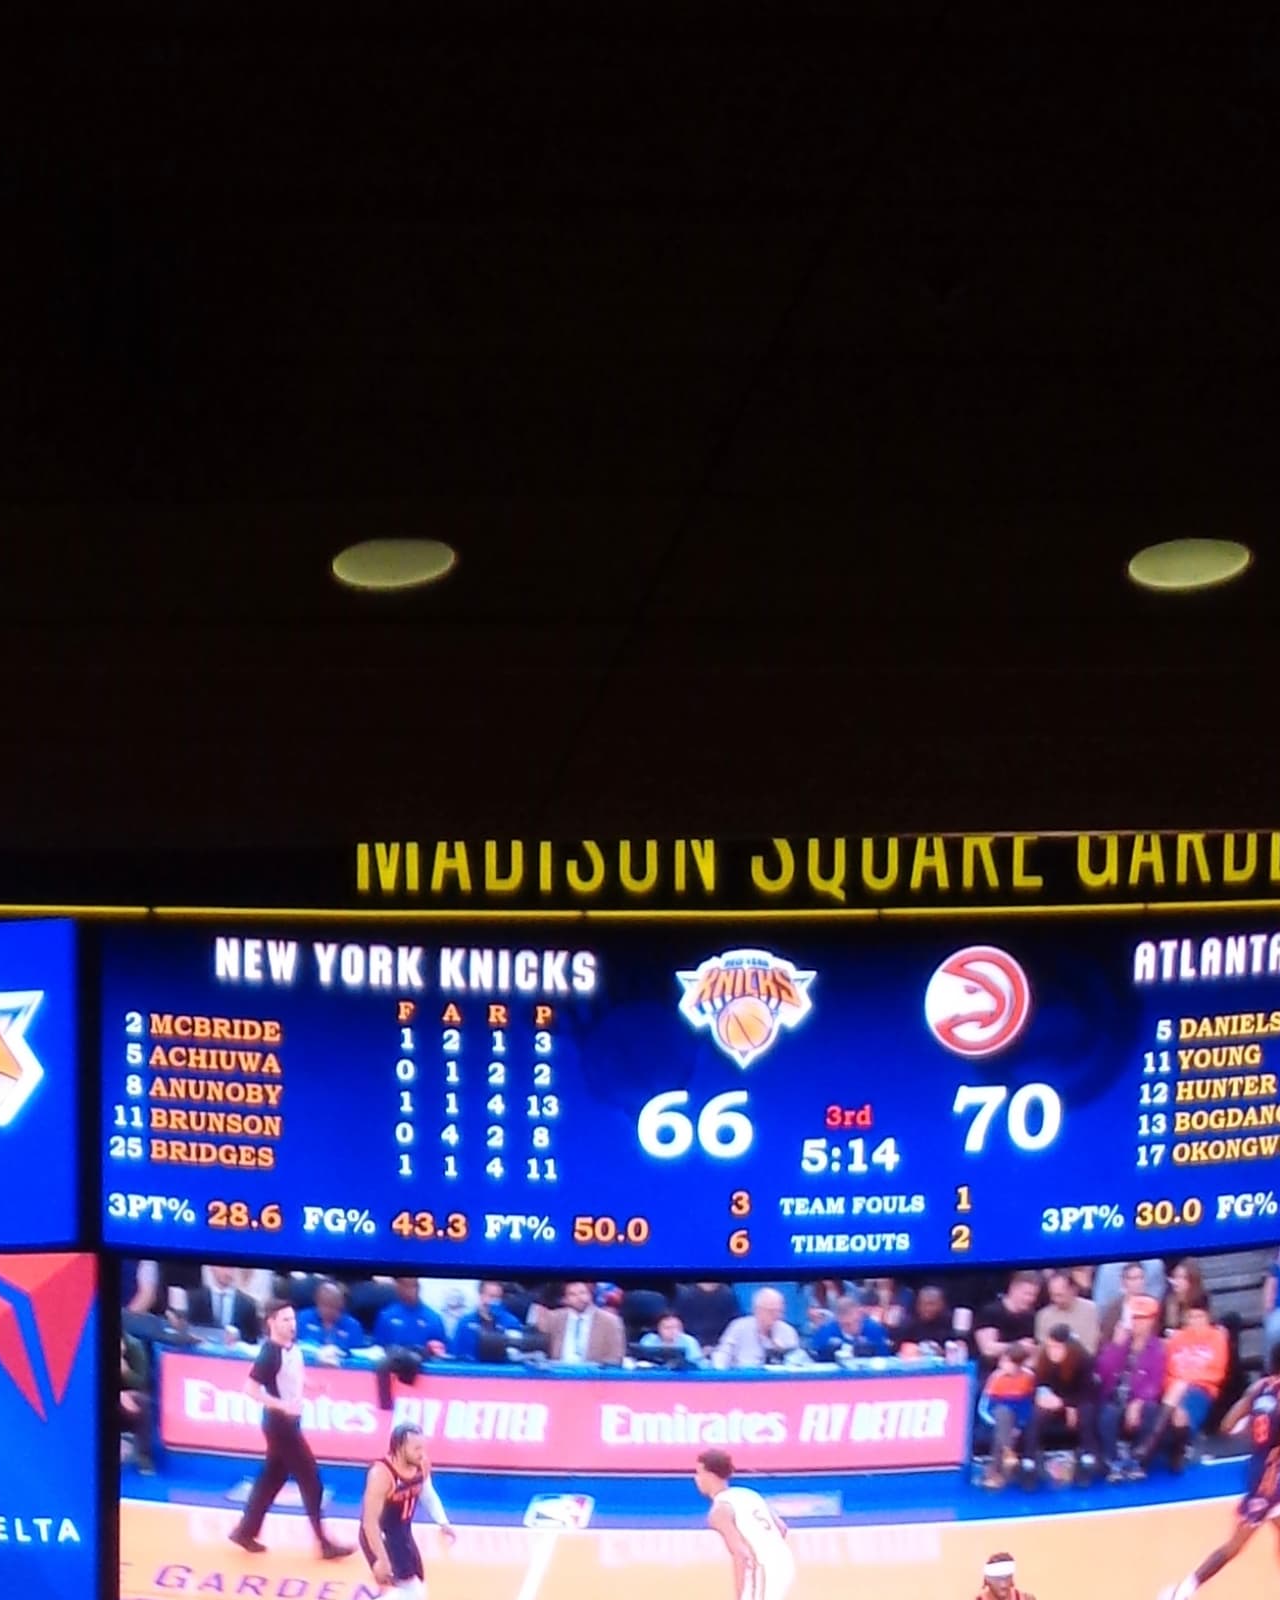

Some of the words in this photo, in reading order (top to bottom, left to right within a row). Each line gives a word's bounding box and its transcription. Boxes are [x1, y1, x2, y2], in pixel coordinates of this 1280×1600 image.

[357, 839, 714, 890] MADISON
[751, 836, 1043, 900] SQUARE
[215, 937, 297, 982] NEW
[313, 942, 424, 989] YORK
[440, 947, 596, 993] KNICKS
[693, 967, 802, 1008] KNICKS
[125, 1011, 143, 1035] 2
[150, 1013, 282, 1045] MCBRIDE
[401, 1027, 414, 1050] 1
[443, 1028, 460, 1052] 2
[492, 1030, 506, 1053] 1
[534, 1031, 552, 1053] 3
[398, 1001, 415, 1021] F
[442, 1003, 462, 1023] A
[488, 1004, 508, 1024] R
[535, 1005, 552, 1026] P
[1156, 1019, 1173, 1041] 5
[126, 1043, 143, 1065] 5
[149, 1045, 282, 1075] ACHIUWA
[396, 1059, 415, 1081] 0
[446, 1061, 459, 1083] 1
[488, 1062, 505, 1085] 2
[534, 1063, 551, 1086] 2
[1143, 1050, 1171, 1074] 11
[1177, 1044, 1262, 1071] YOUNG
[126, 1074, 143, 1096] 8
[149, 1076, 283, 1106] ANUNOBY
[400, 1091, 413, 1113] 1
[446, 1092, 459, 1115] 1
[487, 1094, 505, 1115] 4
[527, 1095, 559, 1117] 13
[1139, 1082, 1169, 1105] 12
[1175, 1073, 1278, 1102] HUNTER
[114, 1104, 144, 1128] 11
[150, 1107, 282, 1137] BRUNSON
[395, 1122, 414, 1144] 0
[441, 1124, 459, 1146] 4
[486, 1125, 504, 1148] 2
[533, 1126, 550, 1148] 8
[637, 1090, 754, 1159] 66
[826, 1104, 872, 1129] 3rd
[953, 1083, 1062, 1152] 70
[1138, 1113, 1167, 1136] 13
[110, 1135, 143, 1158] 25
[150, 1139, 275, 1168] BRIDGES
[399, 1154, 412, 1176] 1
[444, 1155, 458, 1178] 1
[486, 1157, 504, 1178] 4
[527, 1158, 557, 1180] 11
[801, 1137, 900, 1173] 5:14
[1136, 1144, 1166, 1167] 17
[108, 1192, 196, 1223] 3PT%
[207, 1200, 282, 1230] 28.6
[303, 1206, 376, 1234] FG%
[391, 1211, 468, 1240] 43.3
[485, 1214, 556, 1240] FT%
[573, 1216, 649, 1243] 50.0
[731, 1191, 751, 1216] 3
[779, 1197, 845, 1216] TEAM
[852, 1195, 925, 1215] FOULS
[957, 1186, 971, 1211] 1
[1041, 1204, 1125, 1233] 3PT%
[1135, 1198, 1202, 1228] 30.0
[1216, 1191, 1278, 1220] FG%
[729, 1229, 750, 1255] 6
[791, 1233, 910, 1253] TIMEOUTS
[951, 1224, 970, 1250] 2
[600, 1402, 787, 1445] Emirates
